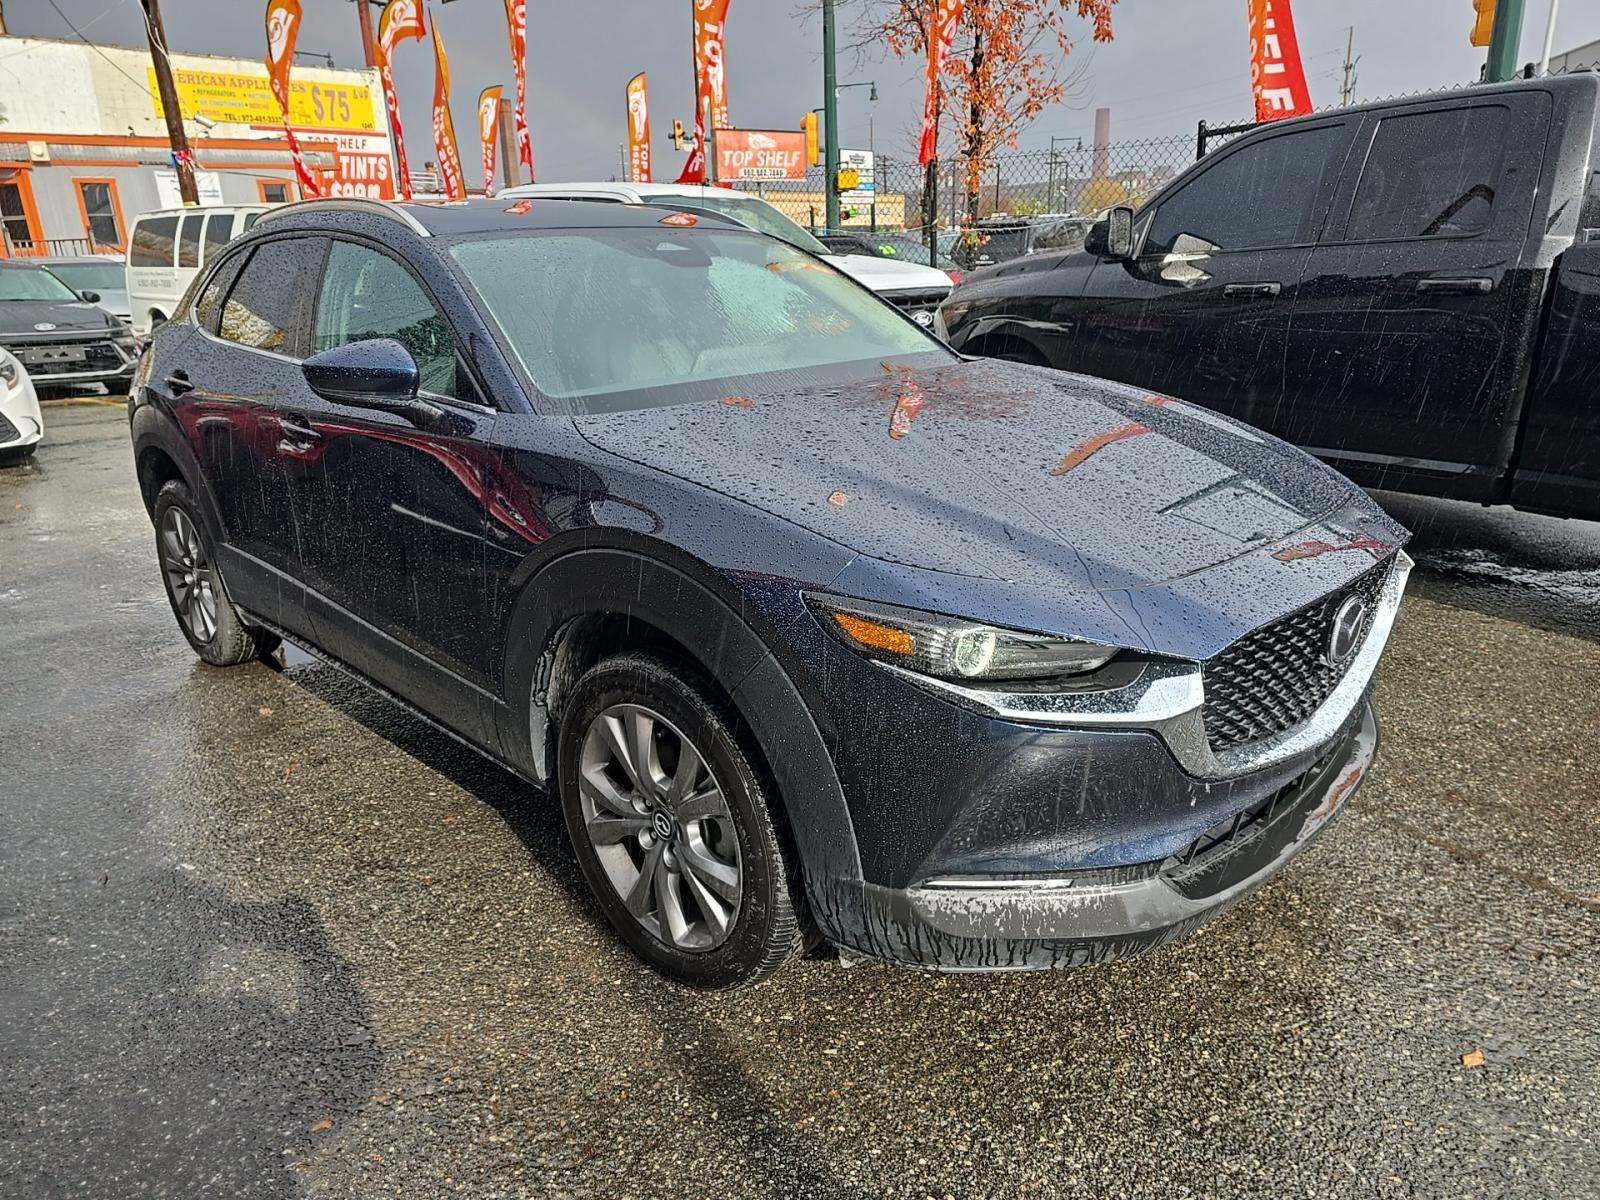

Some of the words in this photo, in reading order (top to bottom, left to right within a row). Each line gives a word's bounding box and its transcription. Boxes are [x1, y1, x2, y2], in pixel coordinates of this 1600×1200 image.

[177, 73, 226, 87] ERICAN
[230, 78, 306, 93] APPLIES
[312, 85, 350, 122] $75
[340, 156, 388, 180] TINTS
[722, 150, 753, 167] TOP
[756, 151, 801, 167] SHELF
